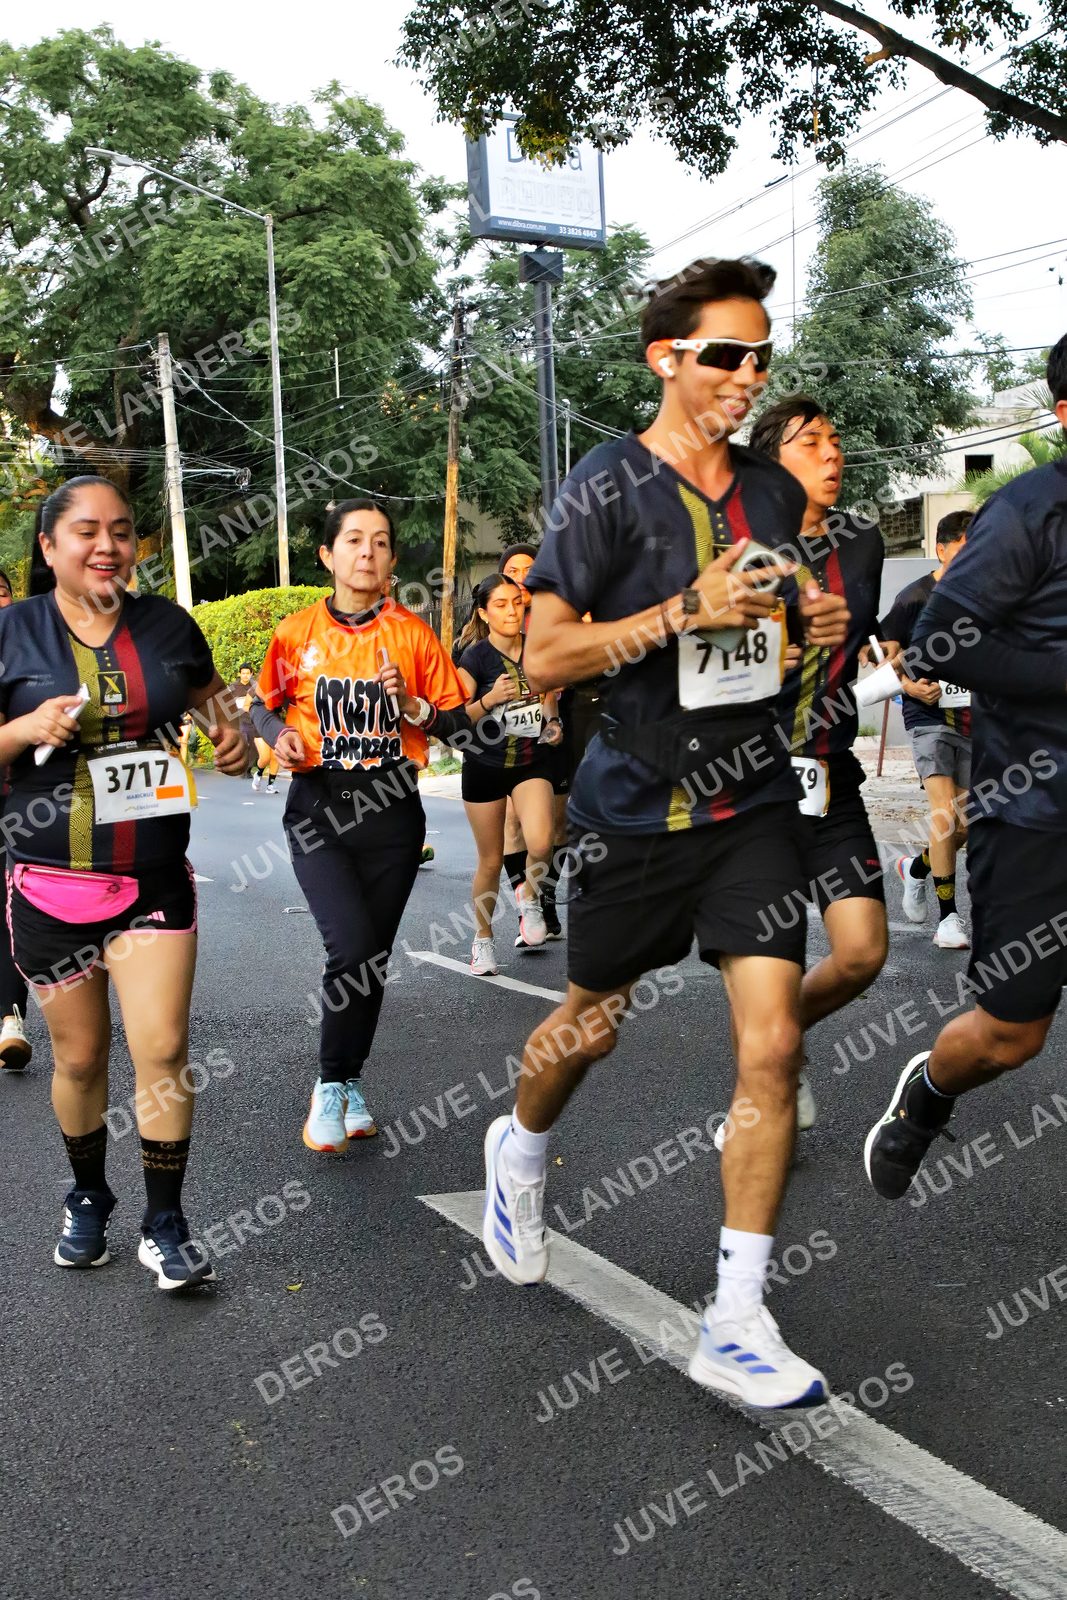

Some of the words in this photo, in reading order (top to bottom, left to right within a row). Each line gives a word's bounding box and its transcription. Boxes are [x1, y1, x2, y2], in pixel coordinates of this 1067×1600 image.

[560, 226, 566, 234] 33
[696, 631, 767, 674] 7148
[512, 709, 541, 727] 7416
[105, 760, 169, 793] 3717
